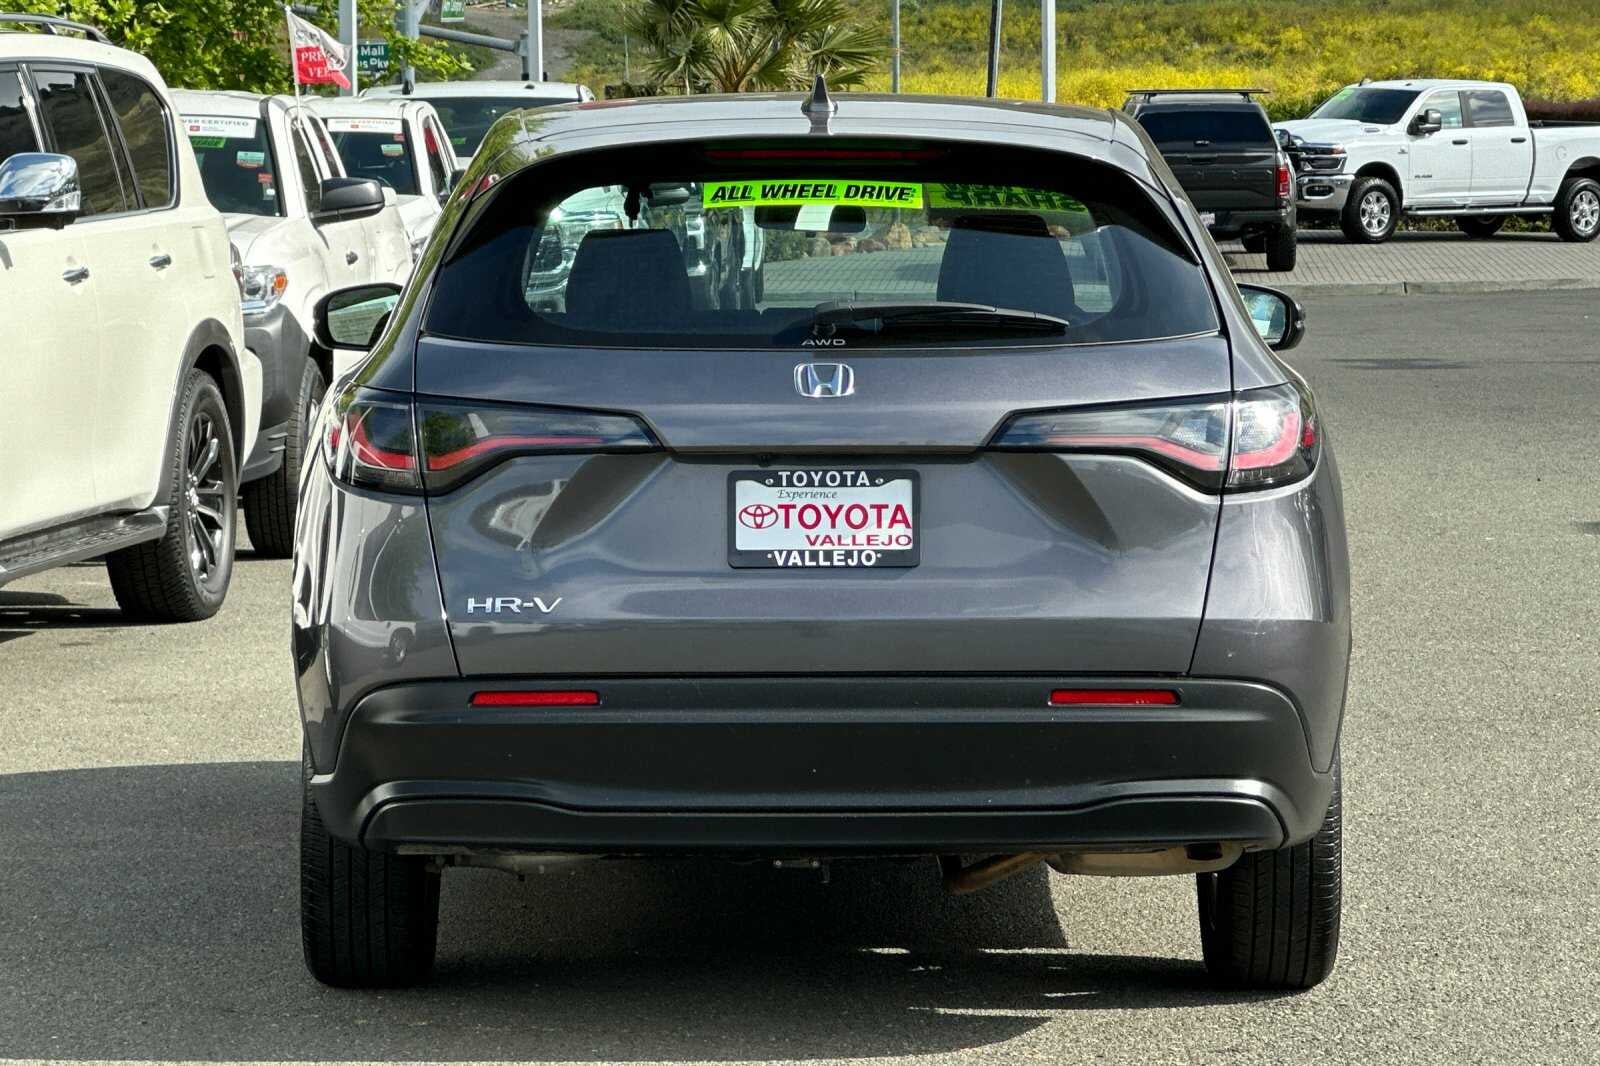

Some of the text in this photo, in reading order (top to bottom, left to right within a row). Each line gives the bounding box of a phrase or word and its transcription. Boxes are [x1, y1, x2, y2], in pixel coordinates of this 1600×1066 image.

[361, 46, 385, 56] Mall
[370, 58, 389, 69] Pkw
[711, 183, 915, 202] ALL WHEEL DRIVE
[801, 338, 846, 346] AWD
[778, 470, 870, 487] TOYOTA
[776, 489, 838, 501] Experience
[777, 503, 912, 530] TOYOTA
[805, 534, 912, 547] VALLEJO
[773, 550, 877, 567] VALLEJO
[467, 597, 563, 614] HR-V
